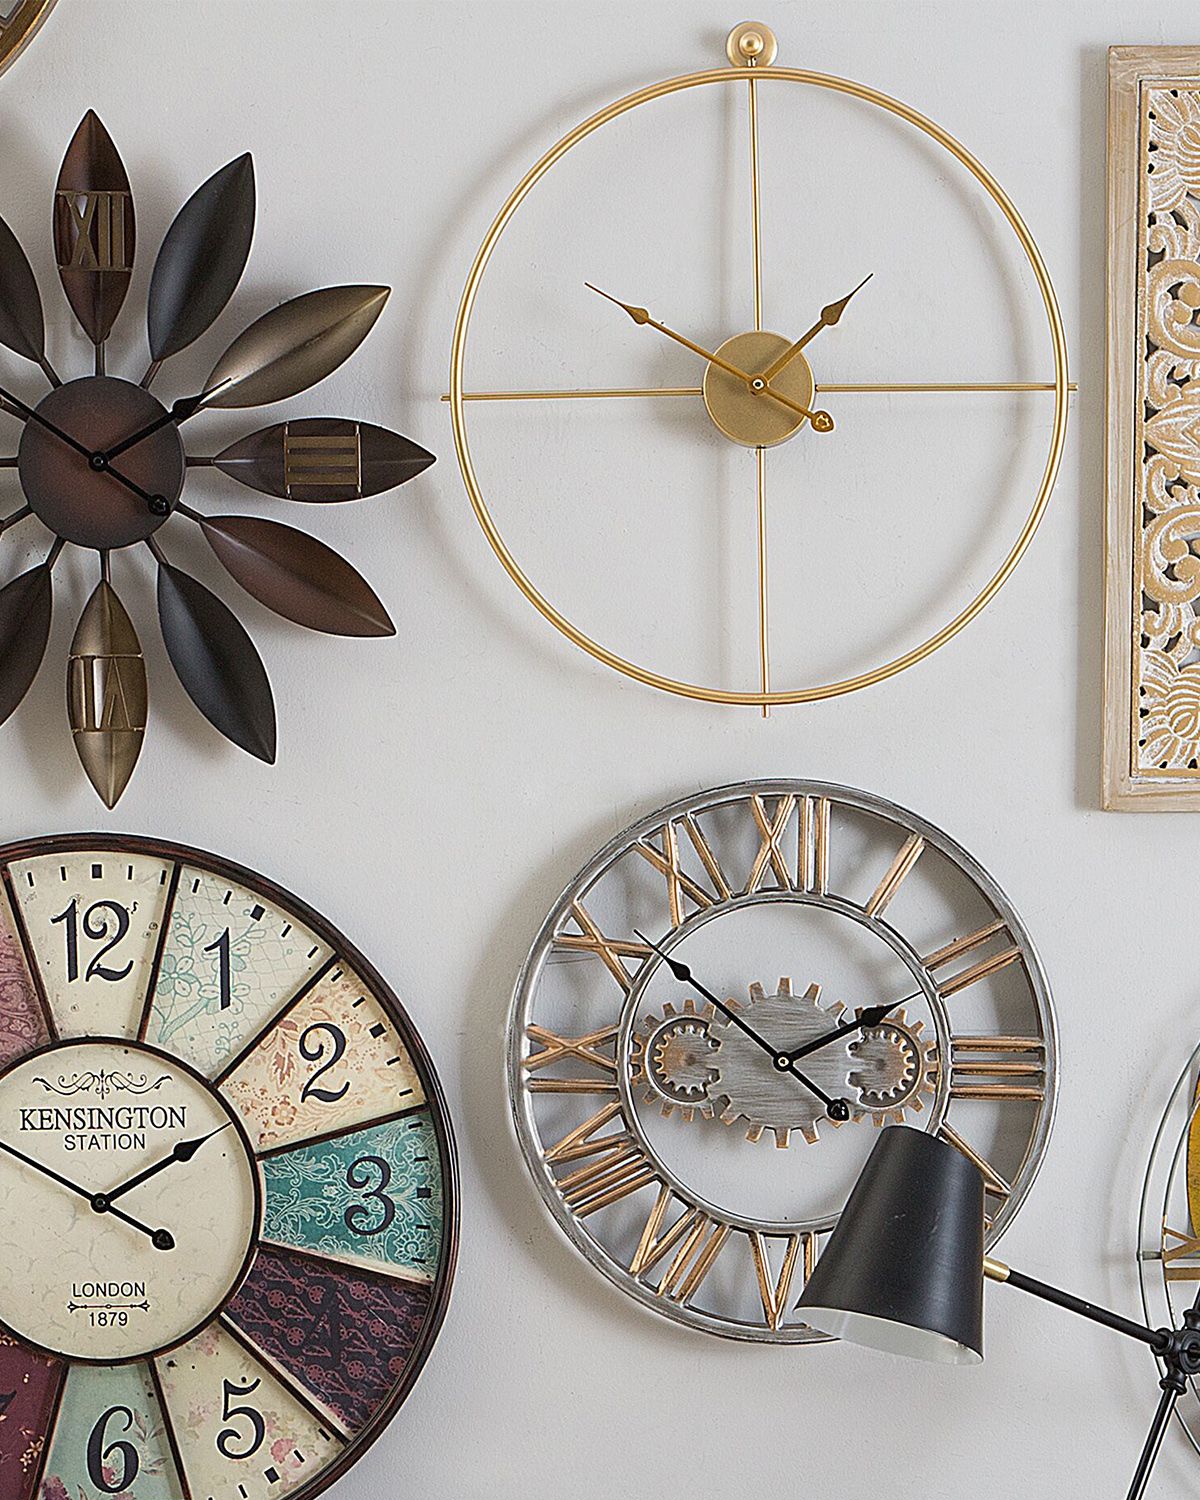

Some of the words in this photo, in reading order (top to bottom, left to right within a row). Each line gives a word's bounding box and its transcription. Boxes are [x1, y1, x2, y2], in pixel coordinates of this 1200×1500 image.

[56, 190, 135, 272] XII
[283, 422, 360, 500] III
[69, 654, 143, 732] VI
[636, 812, 734, 928] XI
[746, 793, 831, 895] XII
[866, 833, 925, 917] I
[49, 899, 136, 983] 12
[204, 927, 232, 1010] 1
[552, 900, 652, 996] X
[921, 918, 1022, 998] II
[298, 1022, 351, 1103] 2
[524, 1022, 619, 1094] IX
[950, 1035, 1044, 1101] III
[19, 1104, 187, 1132] KENSINGTON
[63, 1132, 146, 1151] STATION
[344, 1155, 395, 1236] 3
[544, 1100, 657, 1219] VIII
[630, 1184, 733, 1302] VII
[71, 1281, 146, 1299] LONDON
[87, 1311, 129, 1328] 1879
[85, 1404, 140, 1494] 6
[216, 1378, 266, 1459] 5
